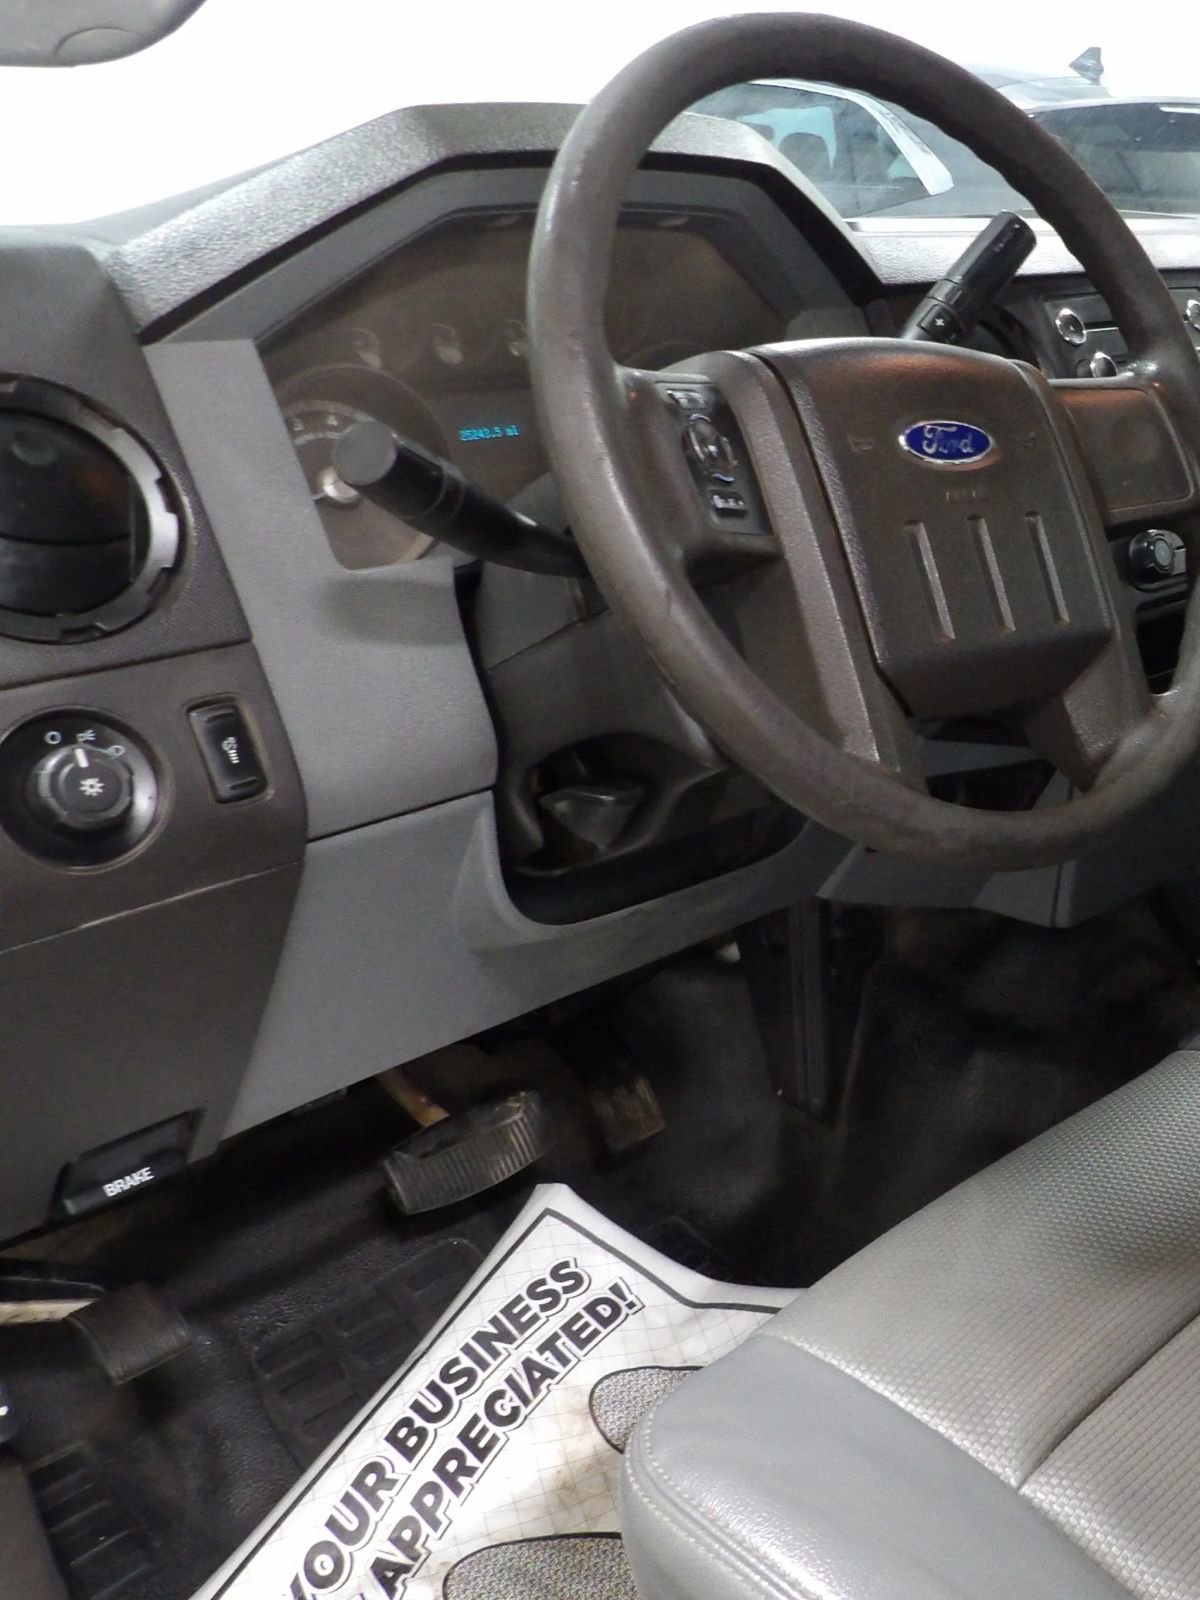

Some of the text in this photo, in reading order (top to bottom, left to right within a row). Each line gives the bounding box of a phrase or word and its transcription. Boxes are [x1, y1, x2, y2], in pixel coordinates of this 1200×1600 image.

[922, 425, 974, 454] Ford
[102, 1166, 154, 1197] BRAKE
[384, 1259, 585, 1464] BUSINESS
[370, 1280, 639, 1600] APPRECIATED!
